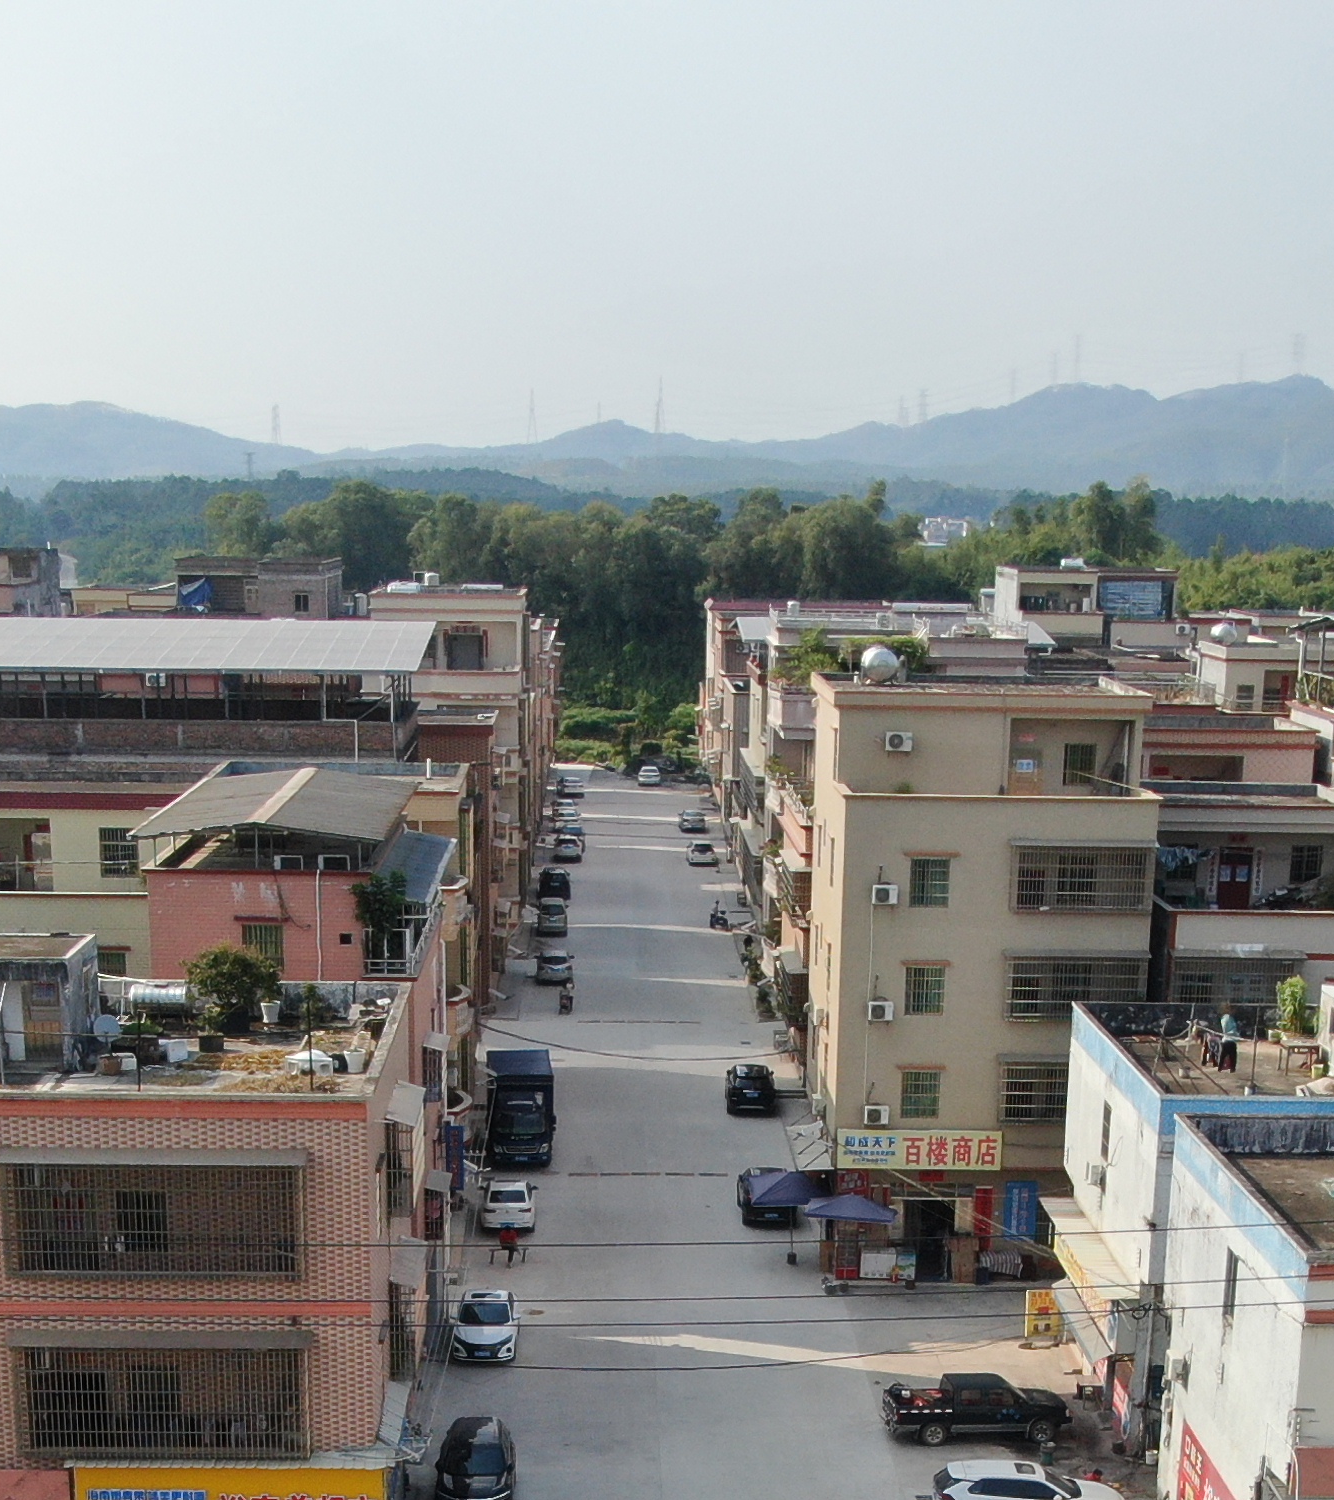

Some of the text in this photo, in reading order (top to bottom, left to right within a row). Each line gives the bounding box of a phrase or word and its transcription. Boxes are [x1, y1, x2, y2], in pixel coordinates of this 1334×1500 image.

[844, 1135, 897, 1148] 和成天下
[902, 1135, 998, 1167] 百楼商店
